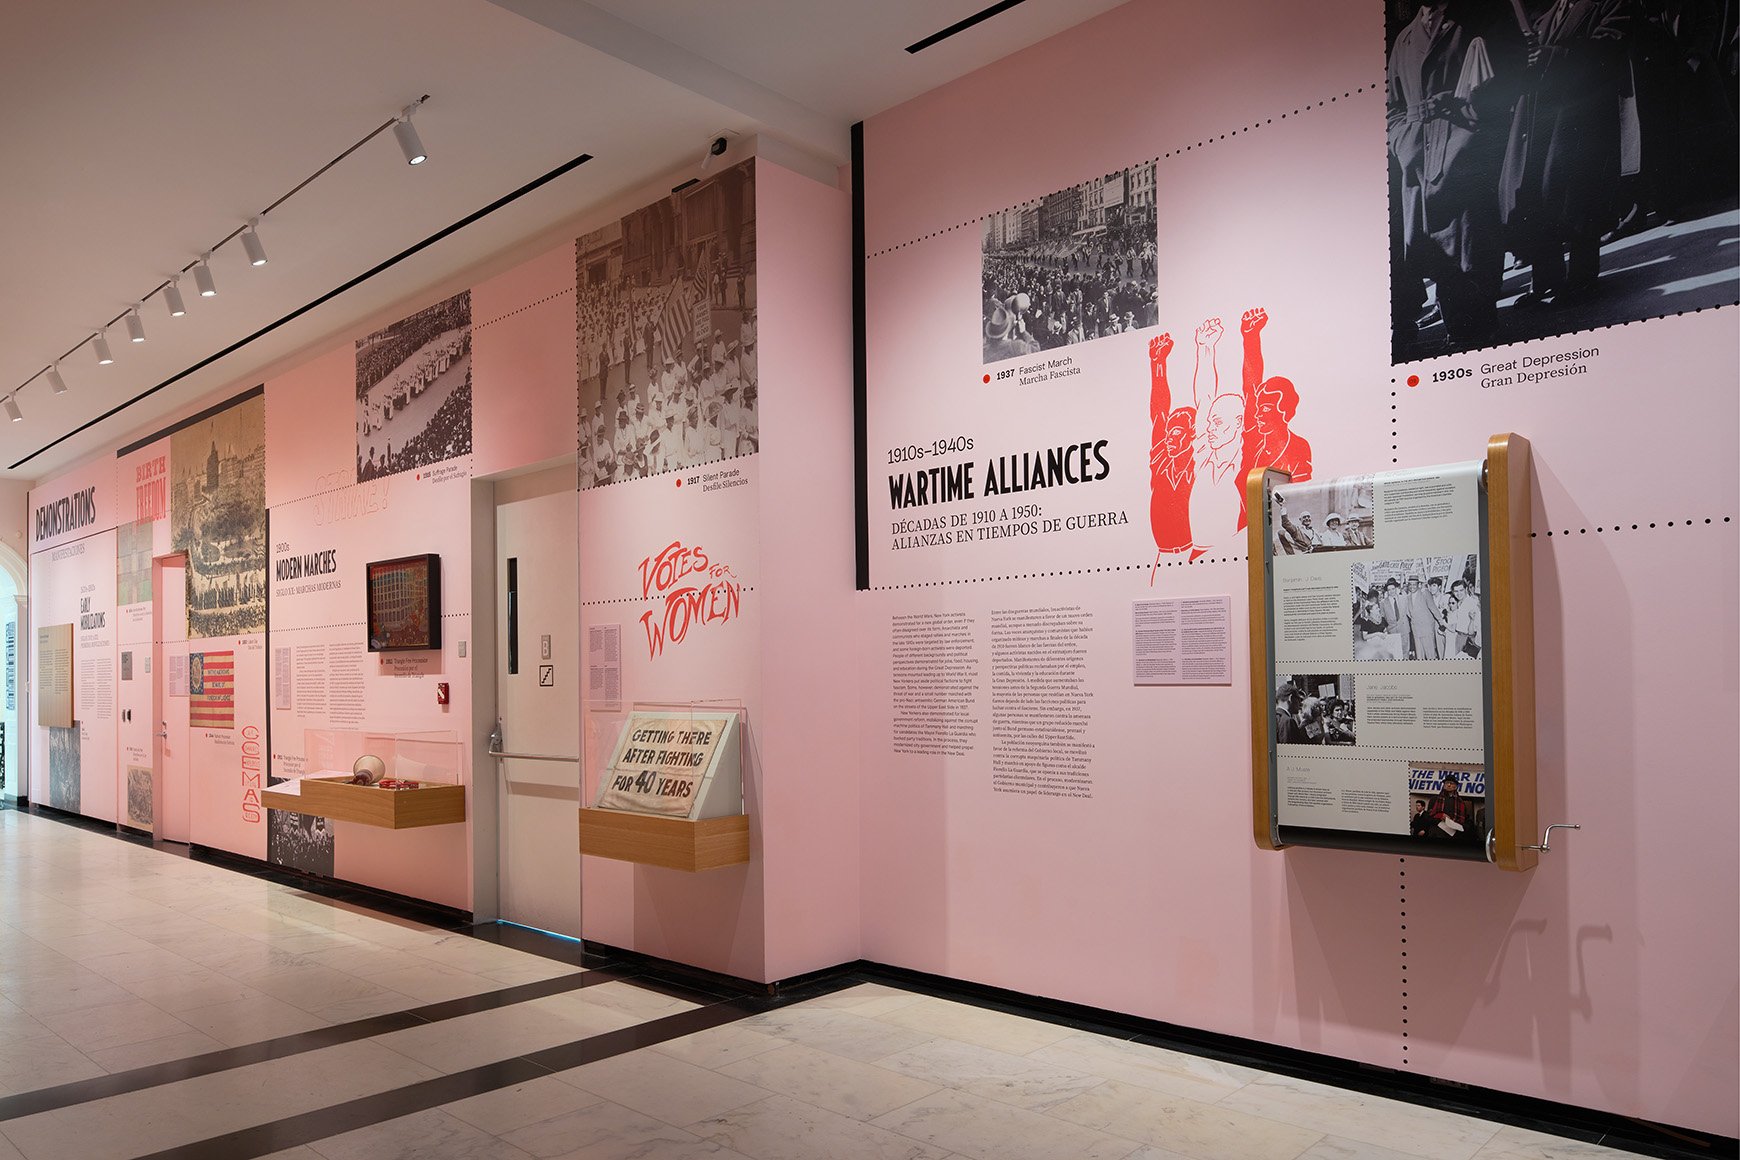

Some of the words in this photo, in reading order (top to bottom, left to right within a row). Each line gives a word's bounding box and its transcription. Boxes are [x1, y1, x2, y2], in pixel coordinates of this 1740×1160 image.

[996, 368, 1015, 381] 1937
[1019, 362, 1046, 376] Fascist
[1048, 356, 1073, 370] March
[1019, 372, 1048, 386] Marcha
[1050, 366, 1081, 380] Fascista
[1432, 367, 1473, 383] 1930s
[1480, 360, 1518, 374] Great
[1522, 346, 1600, 368] Depression
[1480, 374, 1513, 390] Gran
[1516, 363, 1588, 384] Depresión
[136, 456, 166, 484] BIRTH
[688, 476, 700, 486] 1917
[702, 473, 718, 482] Silent
[720, 468, 740, 479] Parade
[888, 461, 975, 510] WARTIME
[983, 439, 1111, 498] ALLIANCES
[702, 482, 722, 492] Desfile
[36, 486, 96, 542] DEMONSTRATIONS
[136, 476, 166, 527] FREEDOM
[891, 532, 953, 551] ALIANZAS
[956, 530, 974, 544] EN
[977, 522, 1038, 542] TIEMPOS
[1042, 518, 1062, 533] DE
[1066, 510, 1130, 531] GUERRA
[892, 515, 947, 535] DÉCADAS
[951, 513, 968, 527] DE
[972, 509, 996, 525] 1910
[1000, 508, 1009, 522] A
[1012, 504, 1043, 520] 1950:
[276, 542, 290, 554] 1900s
[276, 556, 303, 582] MODERN
[304, 549, 337, 578] MARCHES
[638, 540, 709, 602] VOTES
[708, 563, 737, 580] FOR
[296, 584, 316, 594] MARCHAS
[316, 580, 342, 592] MODERNAS
[80, 597, 91, 614] EARLY
[638, 582, 742, 662] WOMEN
[632, 728, 675, 745] GETTING
[676, 730, 712, 746] THERE
[622, 747, 655, 766] AFTER
[656, 750, 704, 768] FIGHTING
[611, 774, 634, 792] FOR
[634, 770, 656, 795] 40
[656, 778, 694, 799] YEARS
[1409, 779, 1462, 792] VIETNM
[1412, 770, 1434, 780] THE
[1438, 770, 1471, 782] WAR
